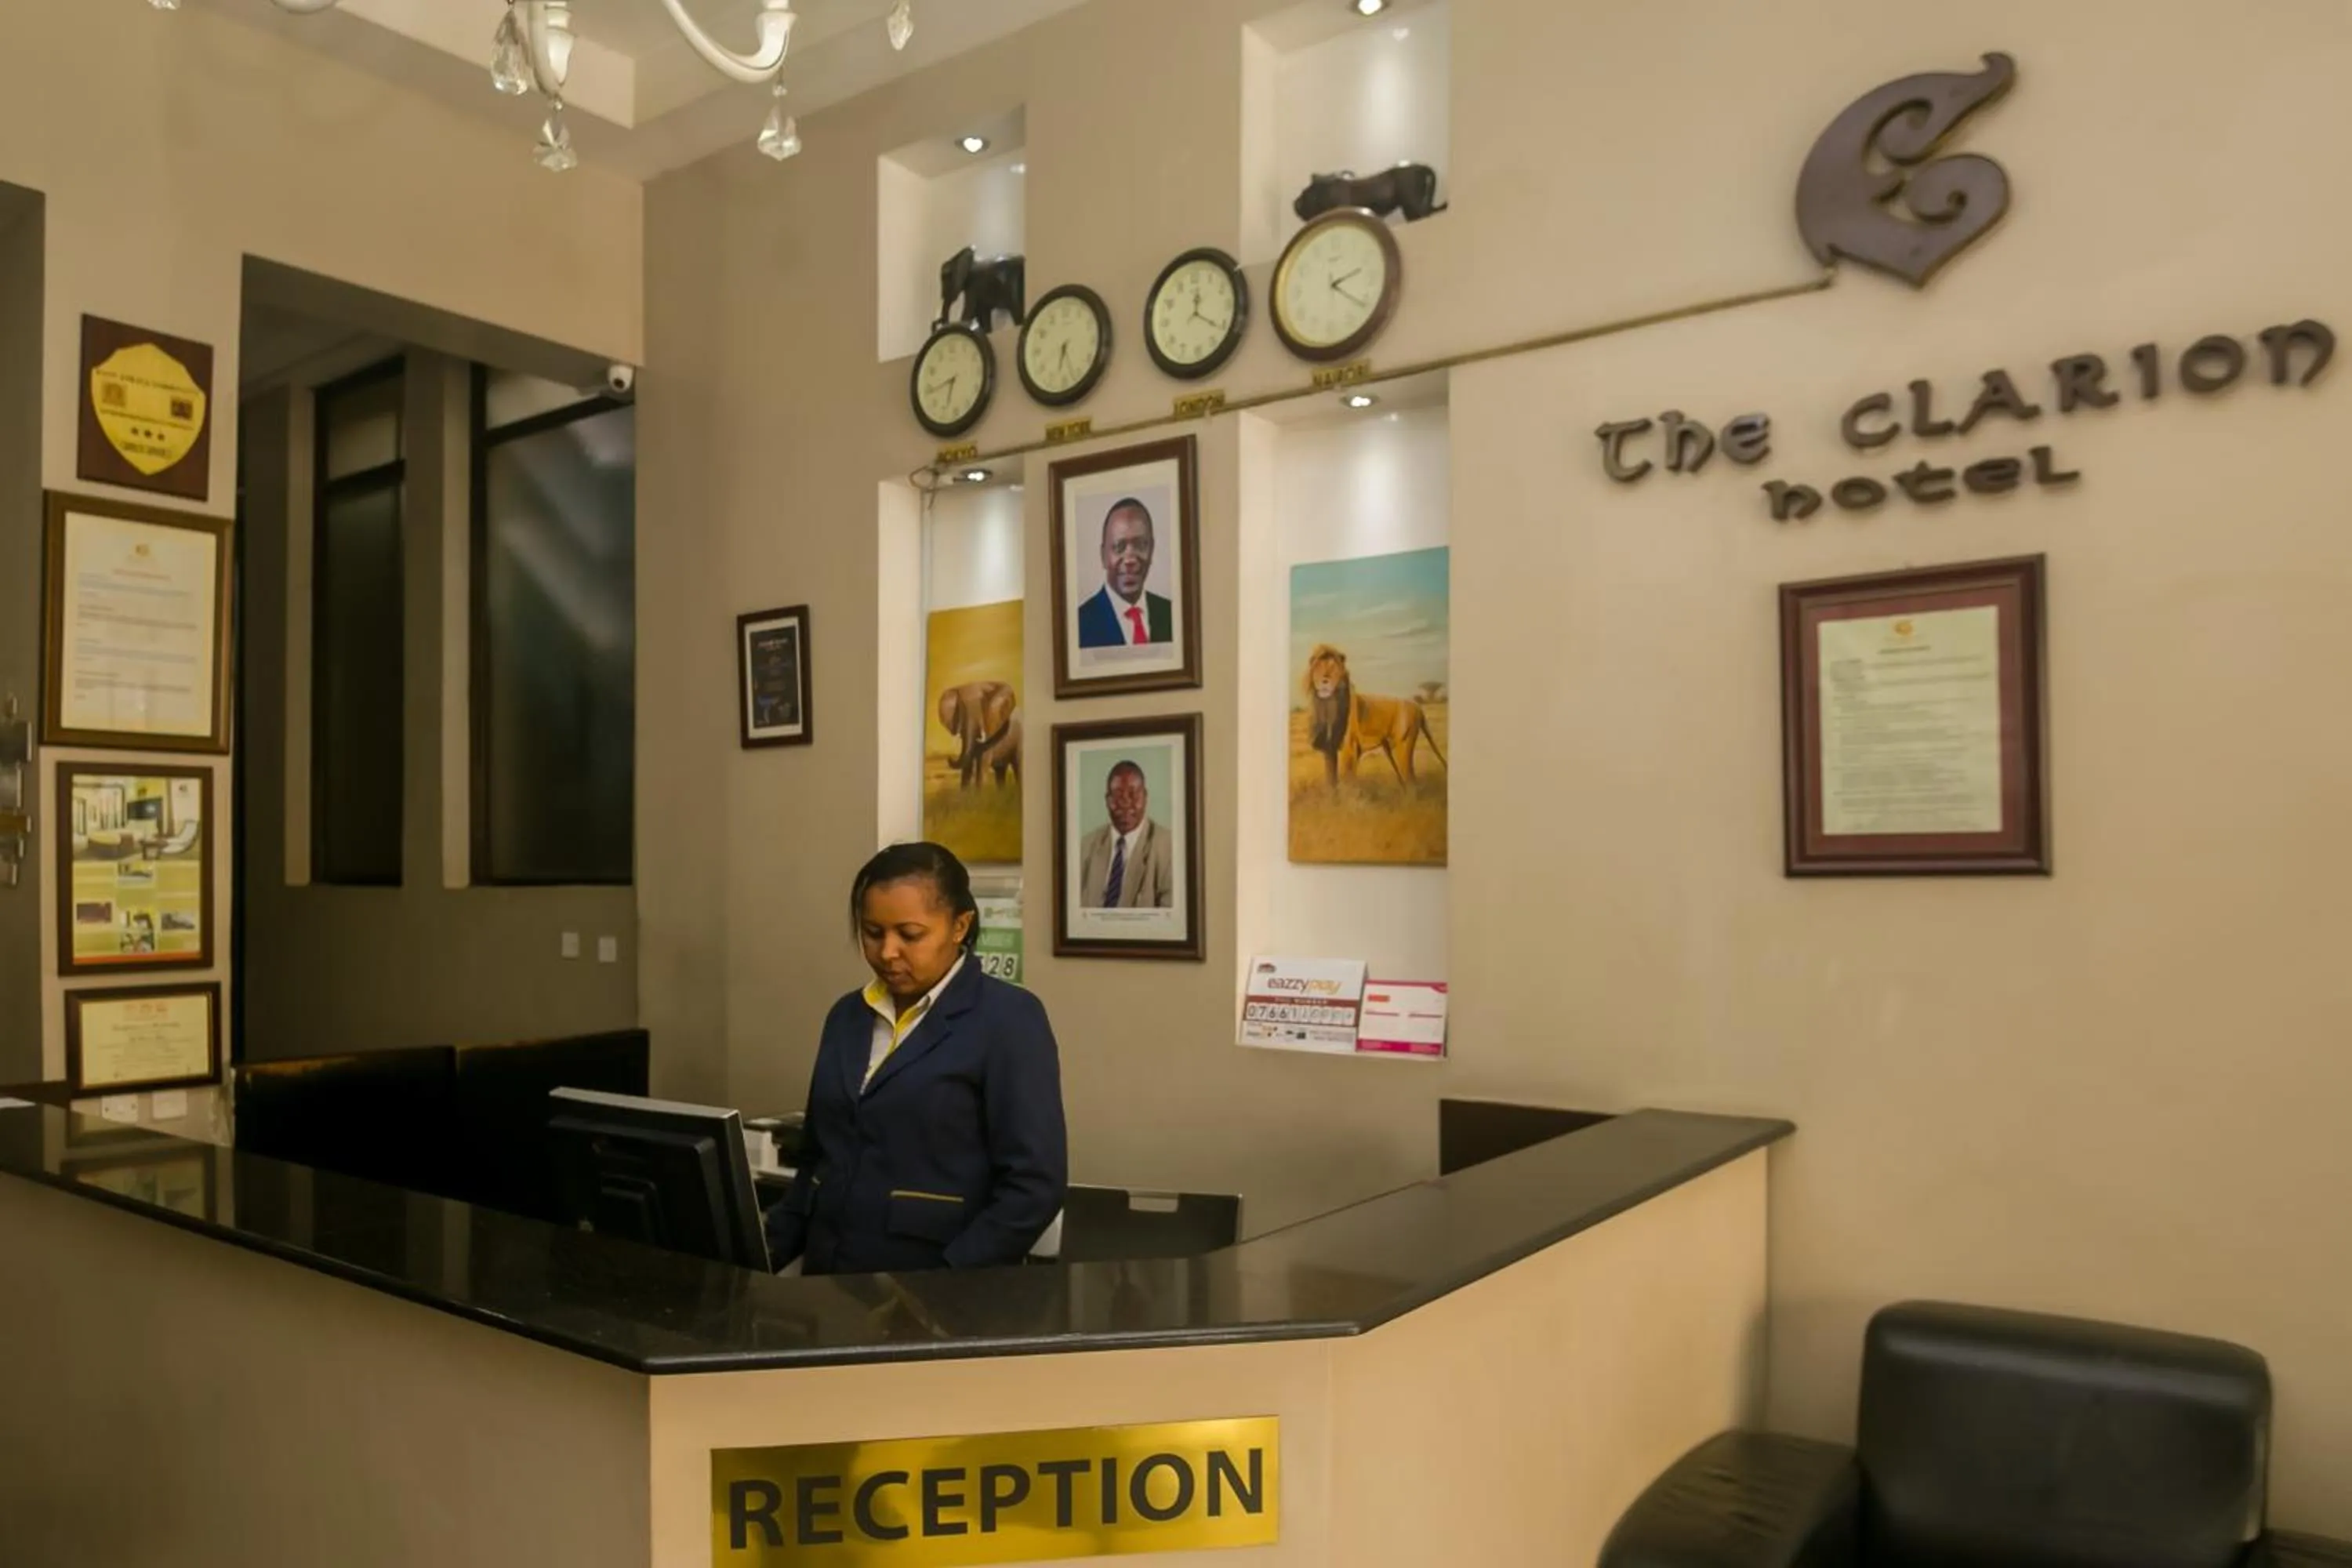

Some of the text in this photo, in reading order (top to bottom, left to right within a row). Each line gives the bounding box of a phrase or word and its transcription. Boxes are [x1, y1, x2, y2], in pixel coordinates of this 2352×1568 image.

[1593, 409, 1772, 484] The
[982, 956, 1014, 977] 28
[728, 1446, 1264, 1550] RECEPTION
